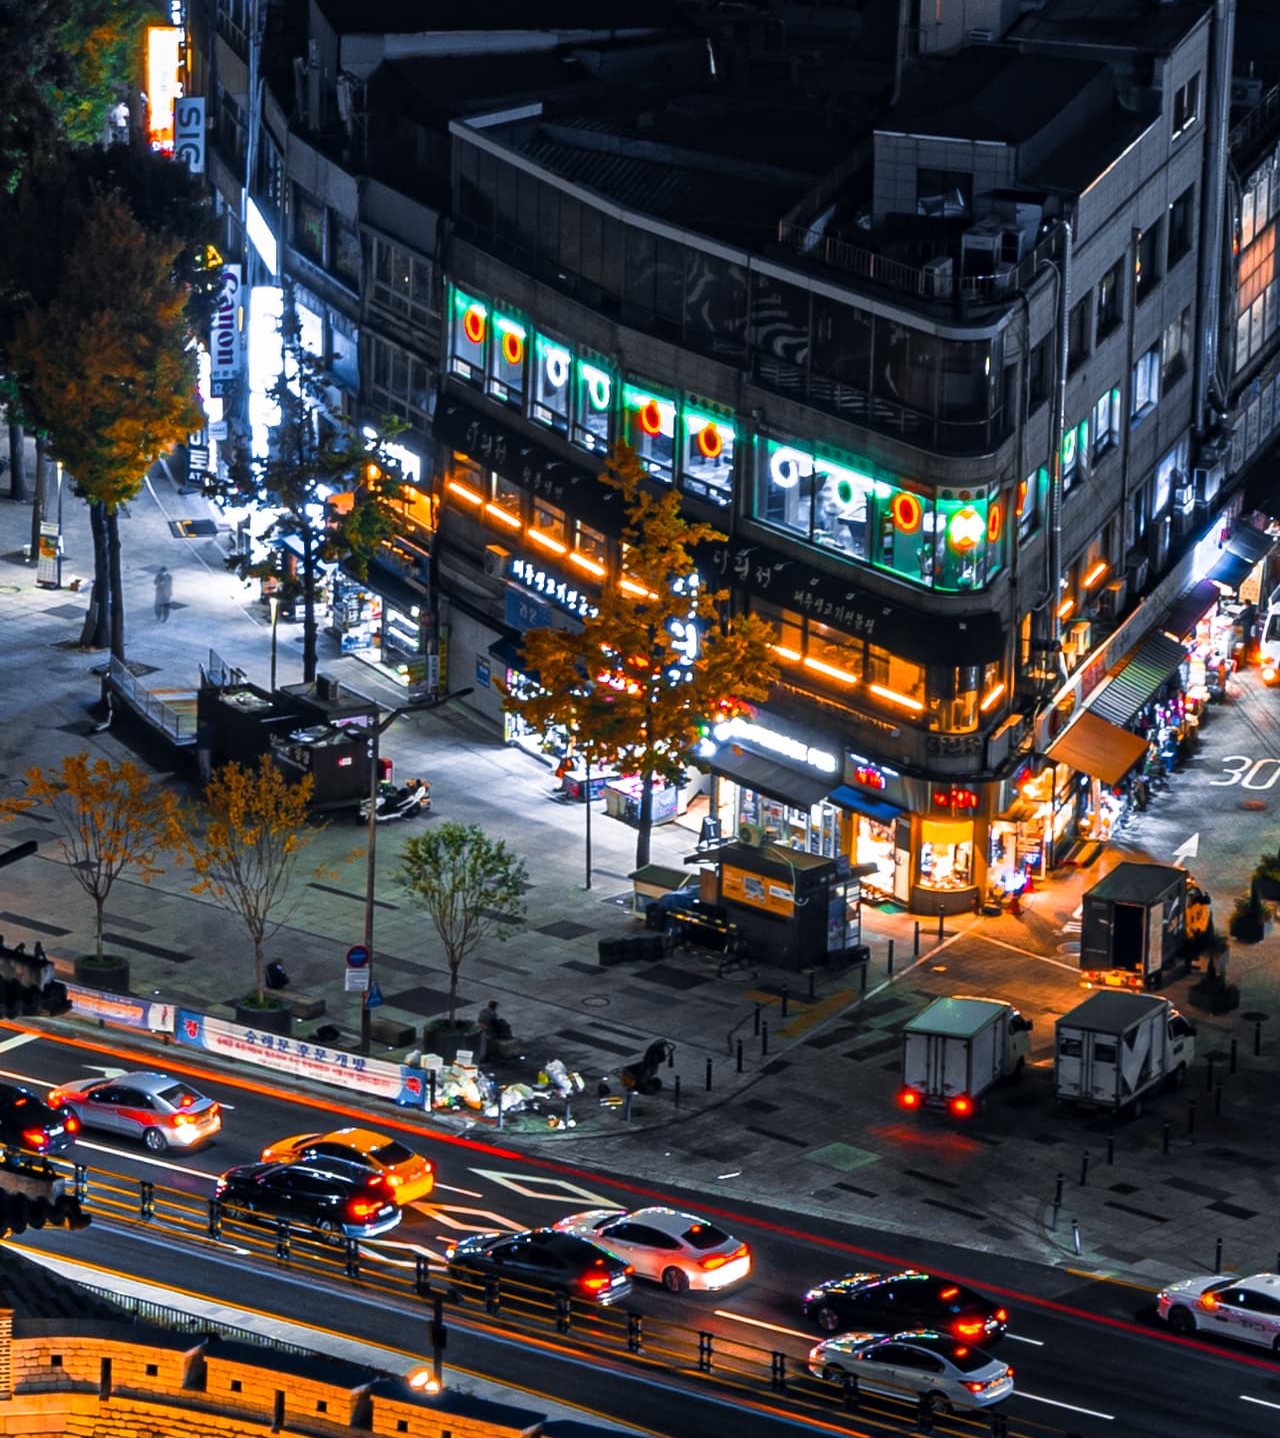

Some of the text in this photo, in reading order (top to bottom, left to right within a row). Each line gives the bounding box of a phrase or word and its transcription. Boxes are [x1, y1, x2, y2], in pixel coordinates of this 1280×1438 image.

[216, 272, 239, 365] Canon
[1209, 755, 1280, 790] 30
[245, 1029, 290, 1053] 숭례문
[296, 1042, 327, 1061] 후문
[334, 1053, 366, 1072] 개방
